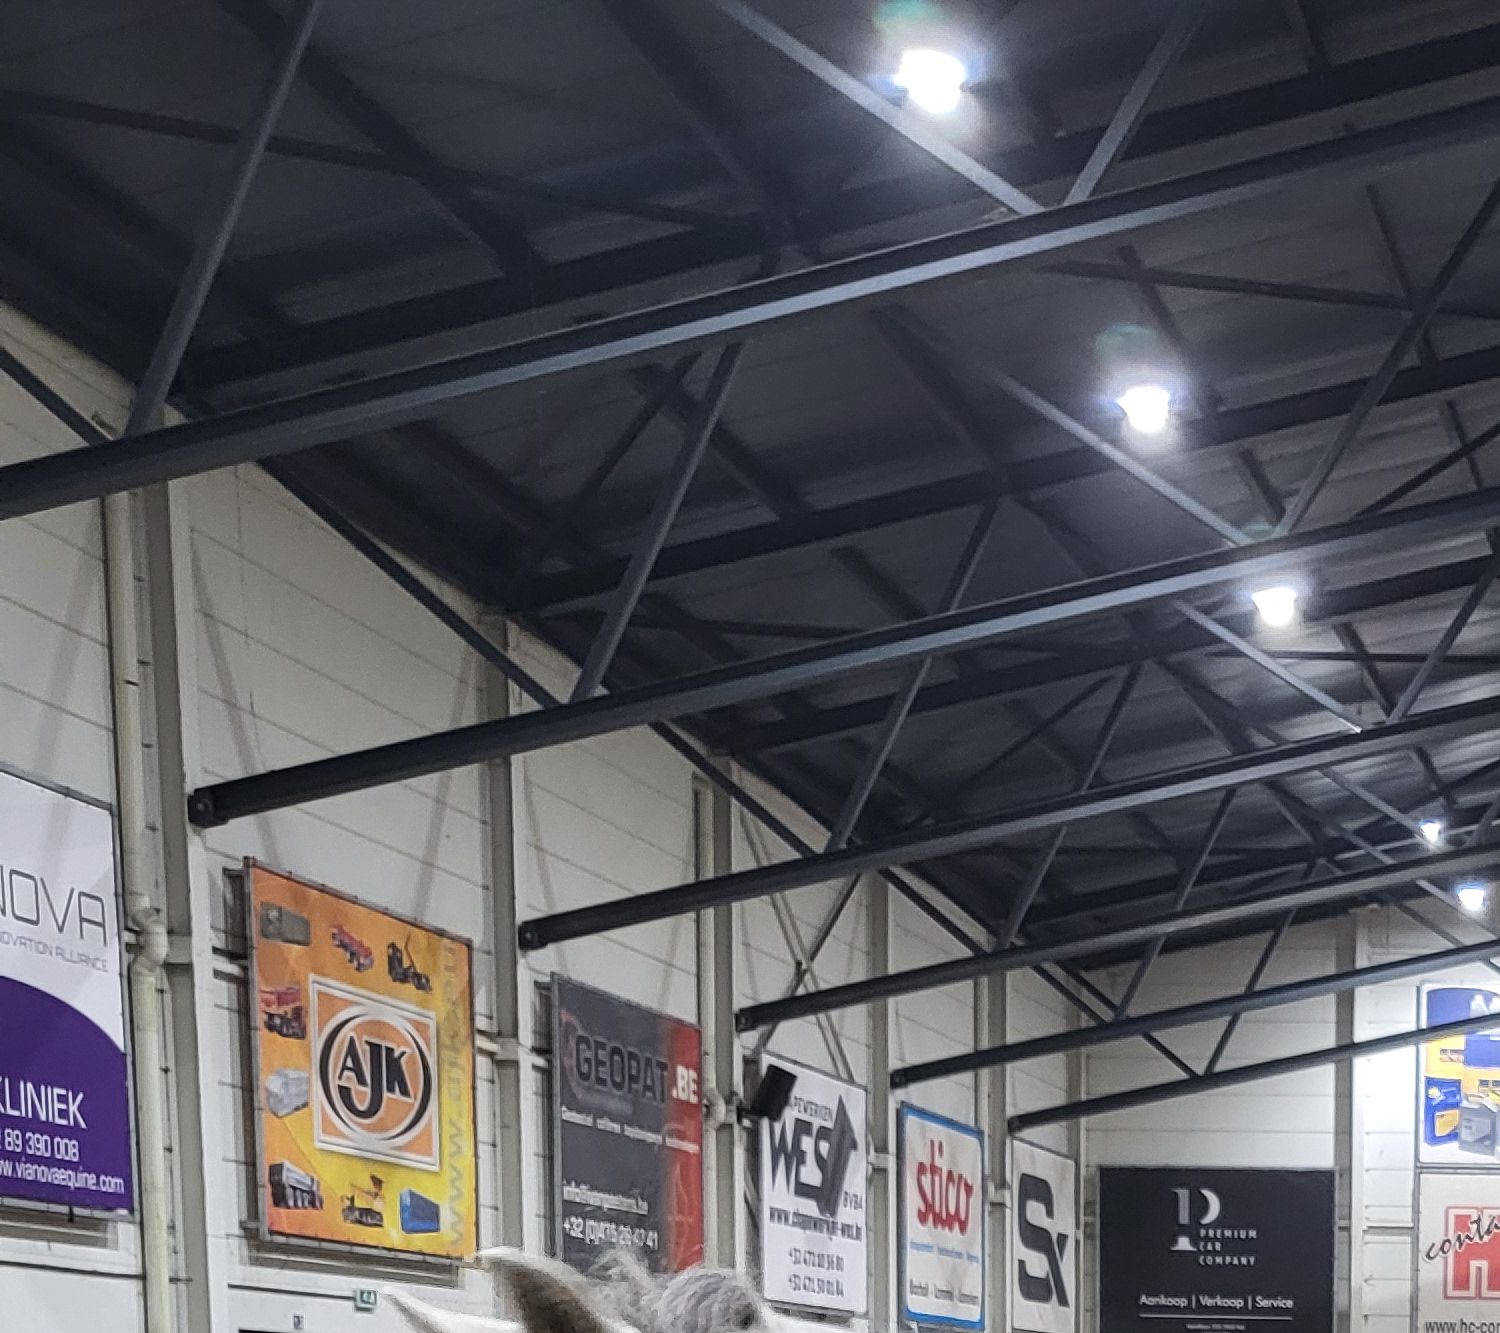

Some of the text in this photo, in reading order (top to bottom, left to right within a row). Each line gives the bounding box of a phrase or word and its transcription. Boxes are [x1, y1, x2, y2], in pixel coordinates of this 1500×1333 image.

[337, 1035, 412, 1121] AJK
[4, 1127, 22, 1153] 89
[25, 1131, 51, 1157] 390
[54, 1136, 79, 1162] 008
[916, 1139, 974, 1237] stico
[1200, 1229, 1257, 1239] PREMIUM
[1199, 1241, 1221, 1252] CAR
[1199, 1255, 1256, 1266] COMPANY
[1139, 1294, 1294, 1309] Aankoop Verkoop Service
